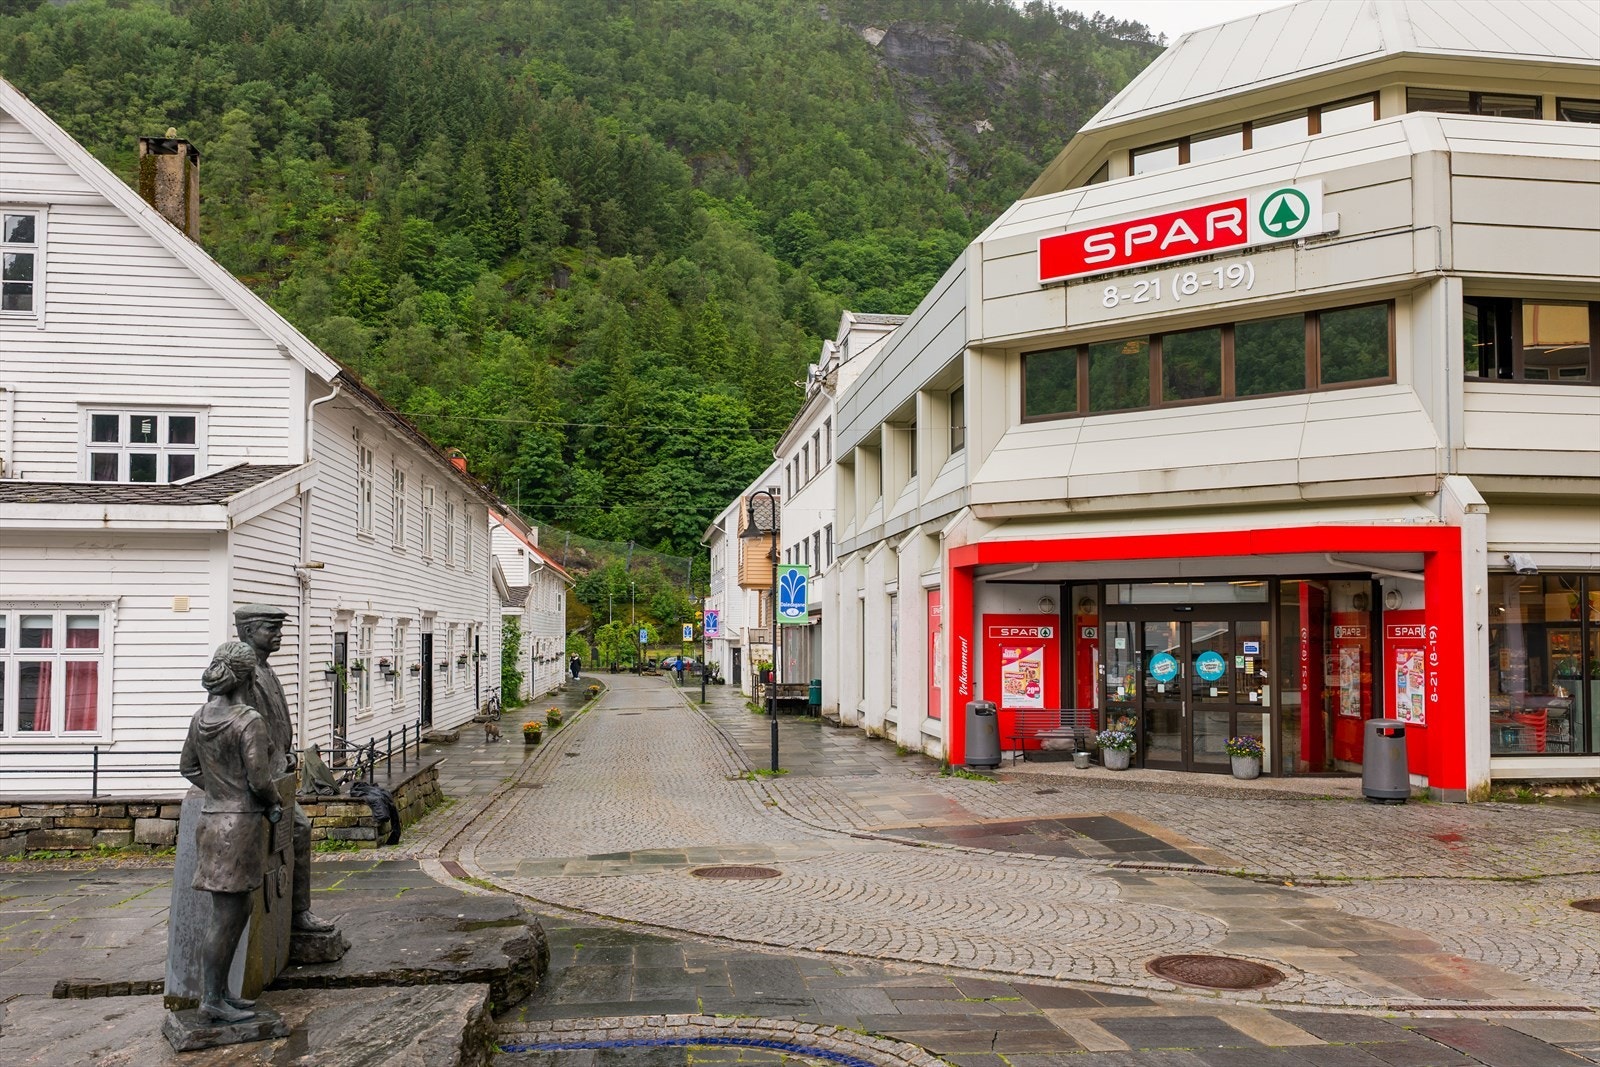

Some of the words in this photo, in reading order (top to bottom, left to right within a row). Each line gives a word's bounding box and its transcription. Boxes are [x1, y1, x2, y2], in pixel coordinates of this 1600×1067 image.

[1084, 207, 1243, 264] SPAR
[1102, 278, 1161, 309] 8-21
[1172, 261, 1256, 302] (8-19)
[1001, 628, 1037, 636] SPAR
[1395, 627, 1421, 636] SPAR
[1429, 626, 1439, 666] (8-19)
[958, 636, 969, 696] Velkommen!
[1430, 671, 1439, 703] 8-21
